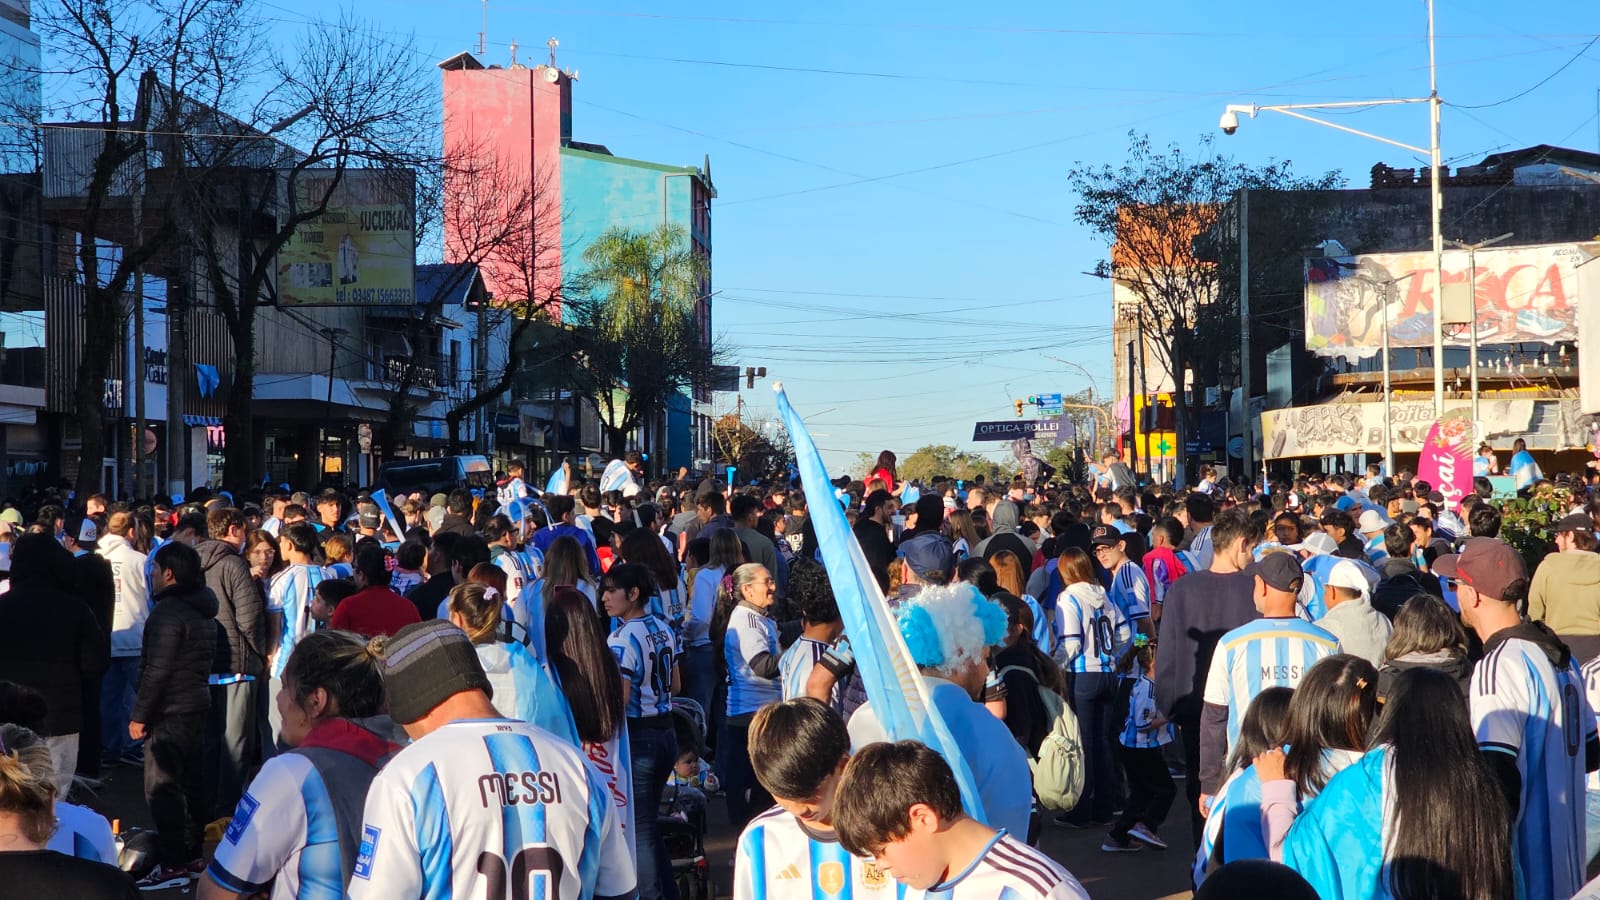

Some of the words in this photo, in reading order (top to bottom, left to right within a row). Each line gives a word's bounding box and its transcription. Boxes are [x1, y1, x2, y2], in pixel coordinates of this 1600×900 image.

[359, 210, 410, 232] SUCURSAL
[980, 424, 1020, 433] OPTICA
[1024, 422, 1059, 432] ROLLEI
[645, 630, 669, 648] MESSI
[1089, 615, 1114, 659] 10
[648, 646, 673, 697] 10
[1261, 665, 1305, 681] MESSI
[478, 771, 562, 808] MESSI
